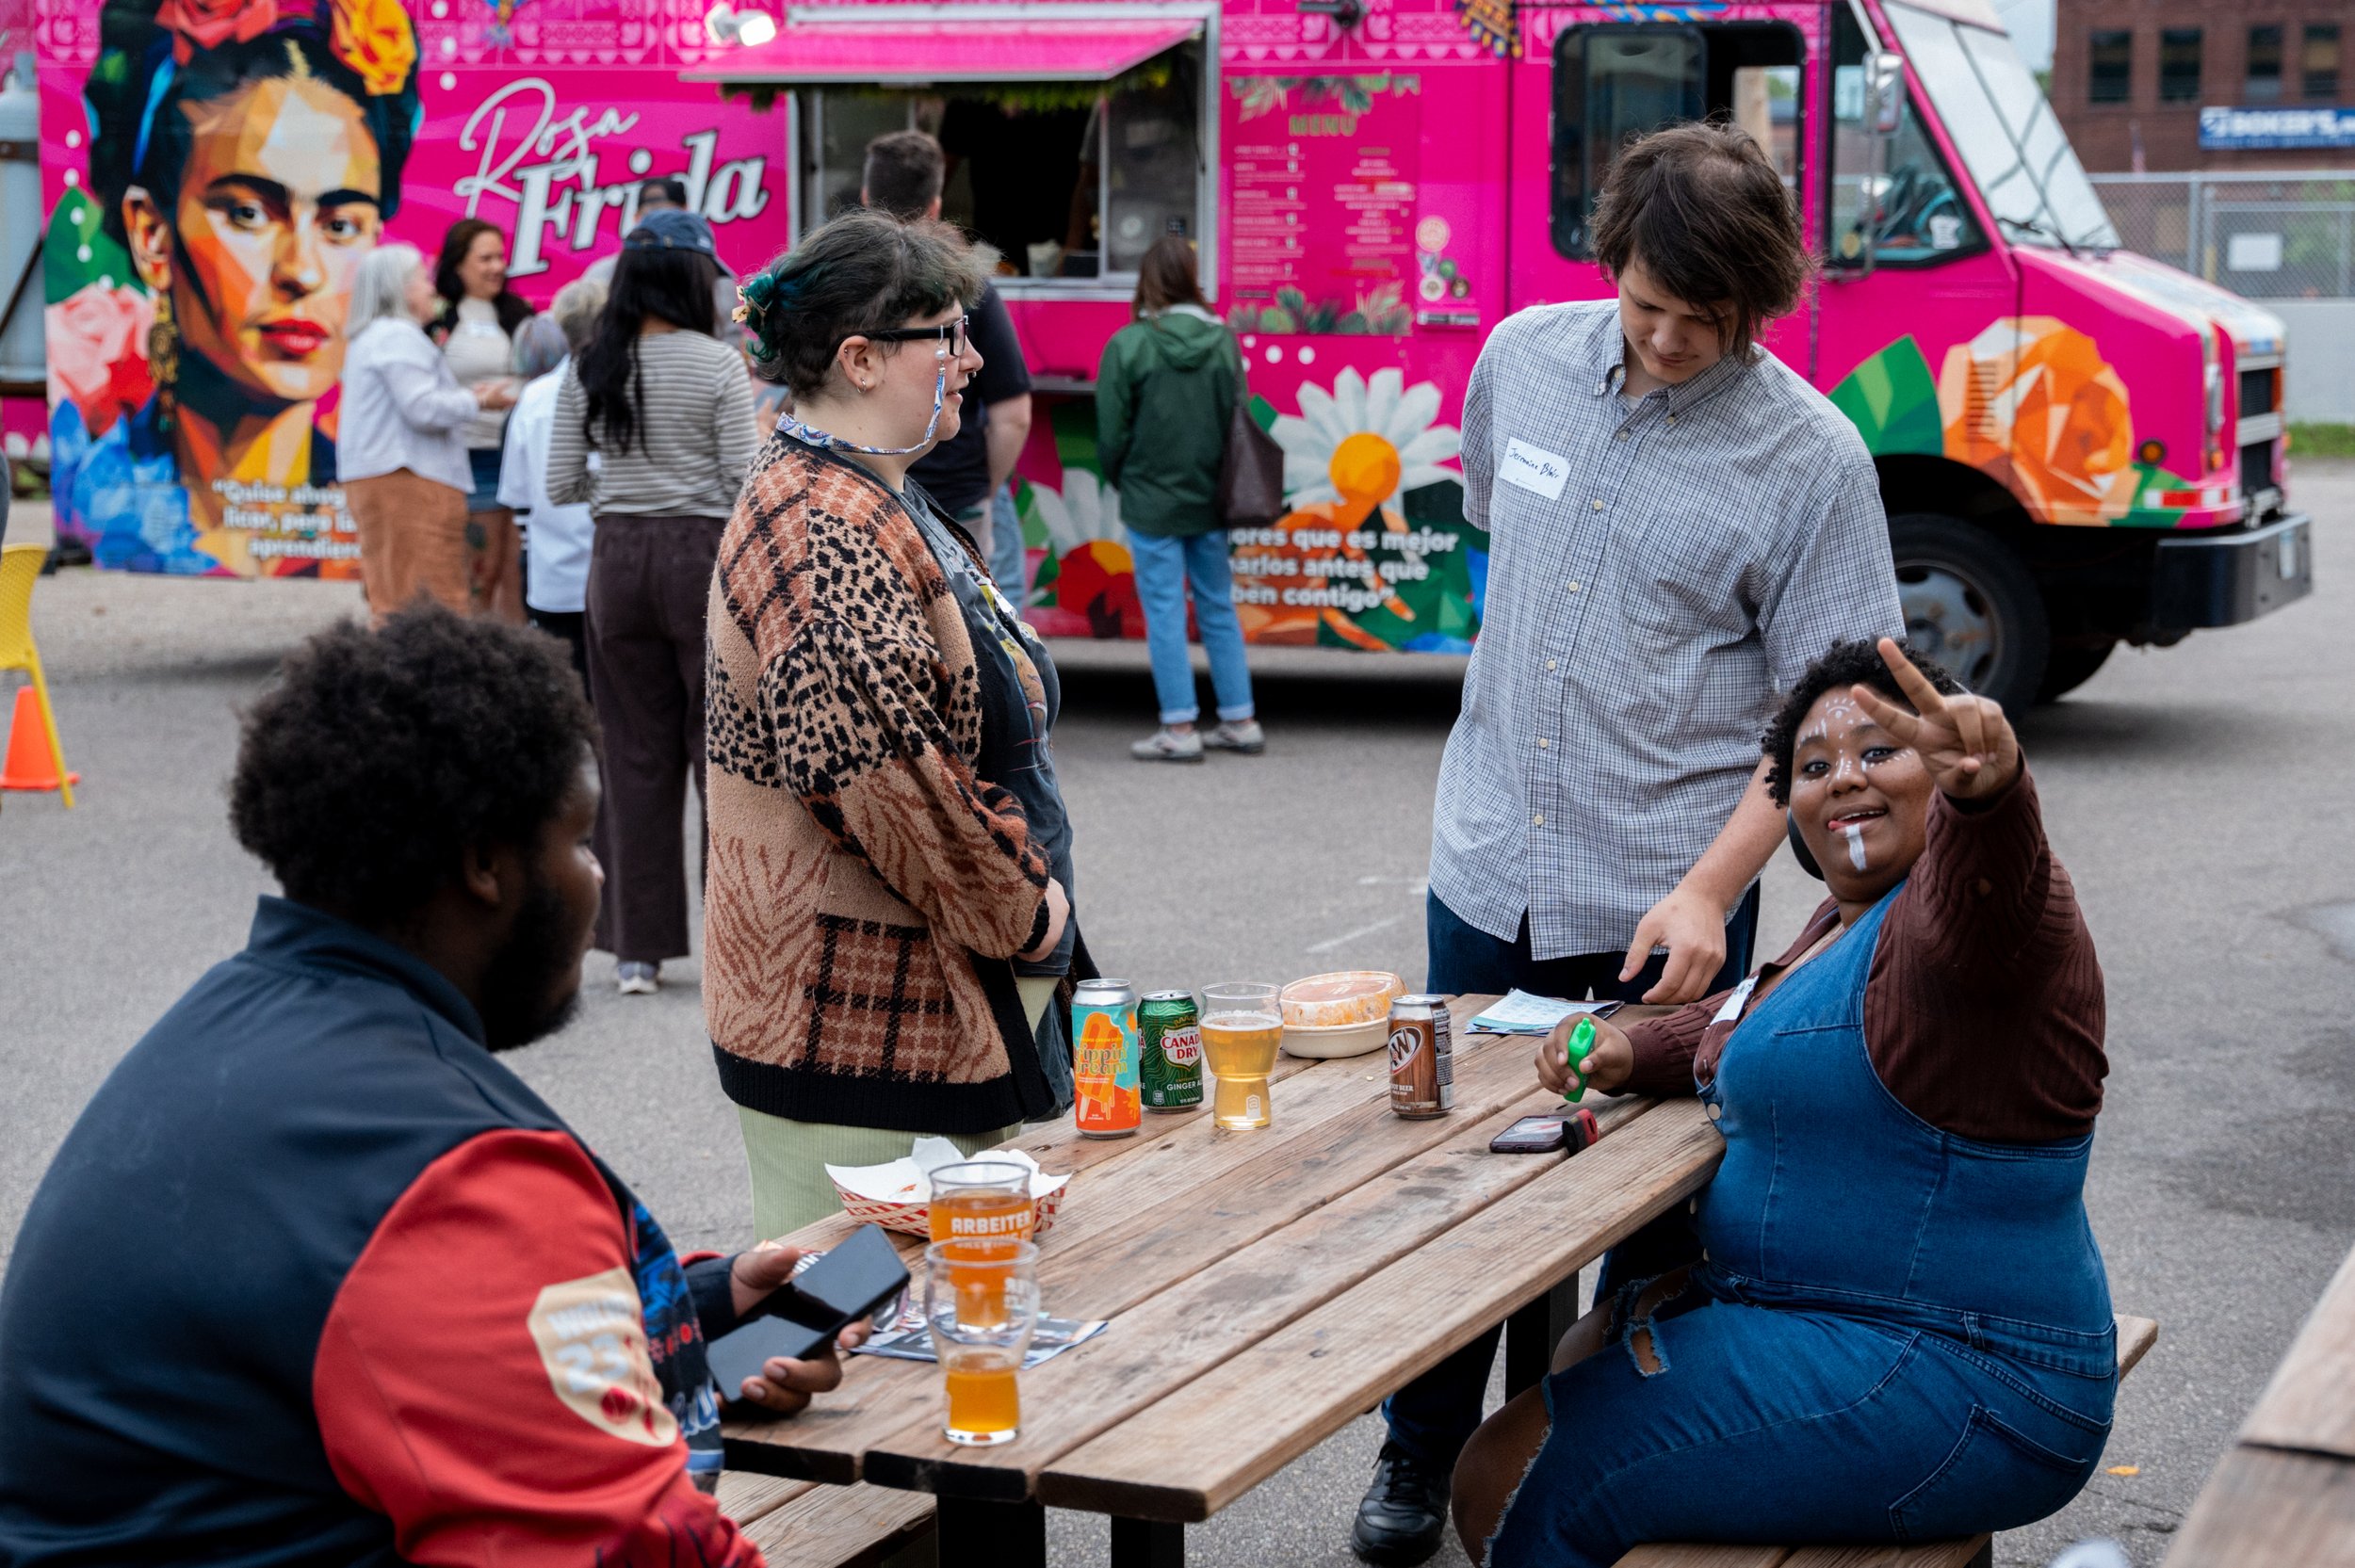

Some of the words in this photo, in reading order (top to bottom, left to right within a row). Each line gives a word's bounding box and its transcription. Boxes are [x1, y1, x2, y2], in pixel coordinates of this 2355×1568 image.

[453, 76, 641, 219] Rosa
[505, 128, 770, 279] Frida
[1291, 529, 1341, 552] que
[1345, 529, 1377, 550] es
[1380, 525, 1460, 556] mejor
[1302, 558, 1374, 579] antes
[1378, 560, 1431, 584] que
[1177, 1046, 1198, 1059] DRY
[1166, 1081, 1196, 1091] GINGER
